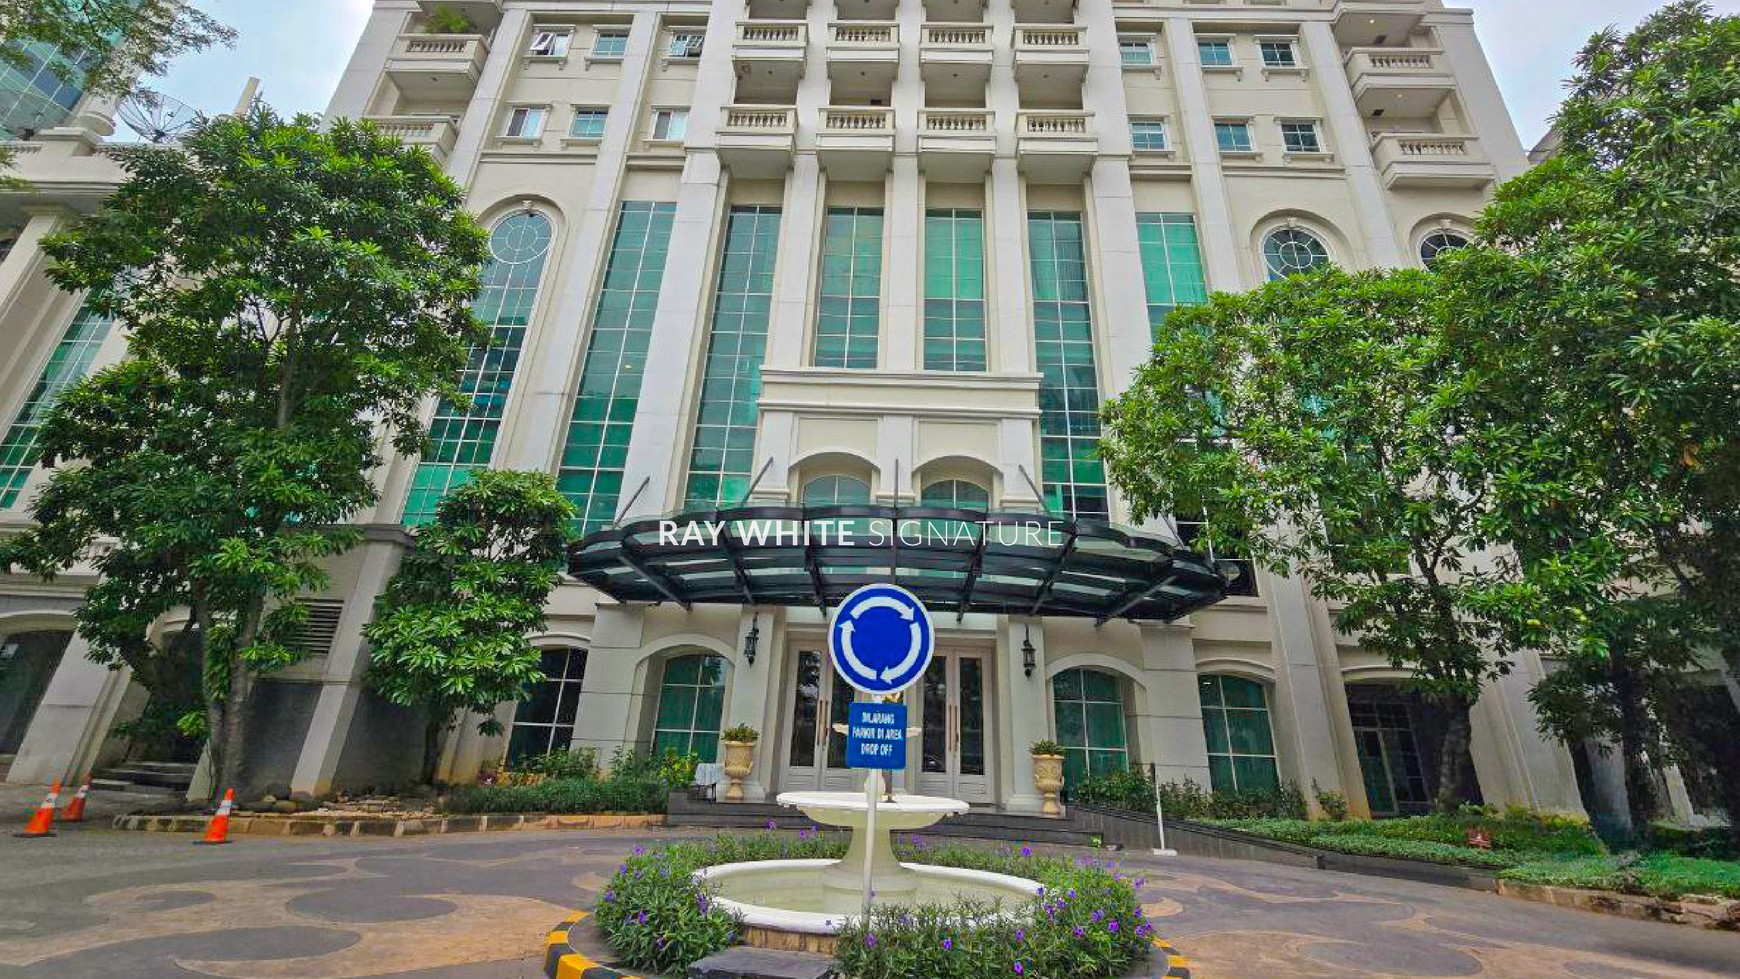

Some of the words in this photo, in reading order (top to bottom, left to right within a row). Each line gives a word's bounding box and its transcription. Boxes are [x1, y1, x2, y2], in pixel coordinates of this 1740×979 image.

[877, 727, 884, 739] DI
[885, 728, 902, 740] AREA
[861, 743, 879, 756] DROP
[880, 743, 893, 756] OFF
